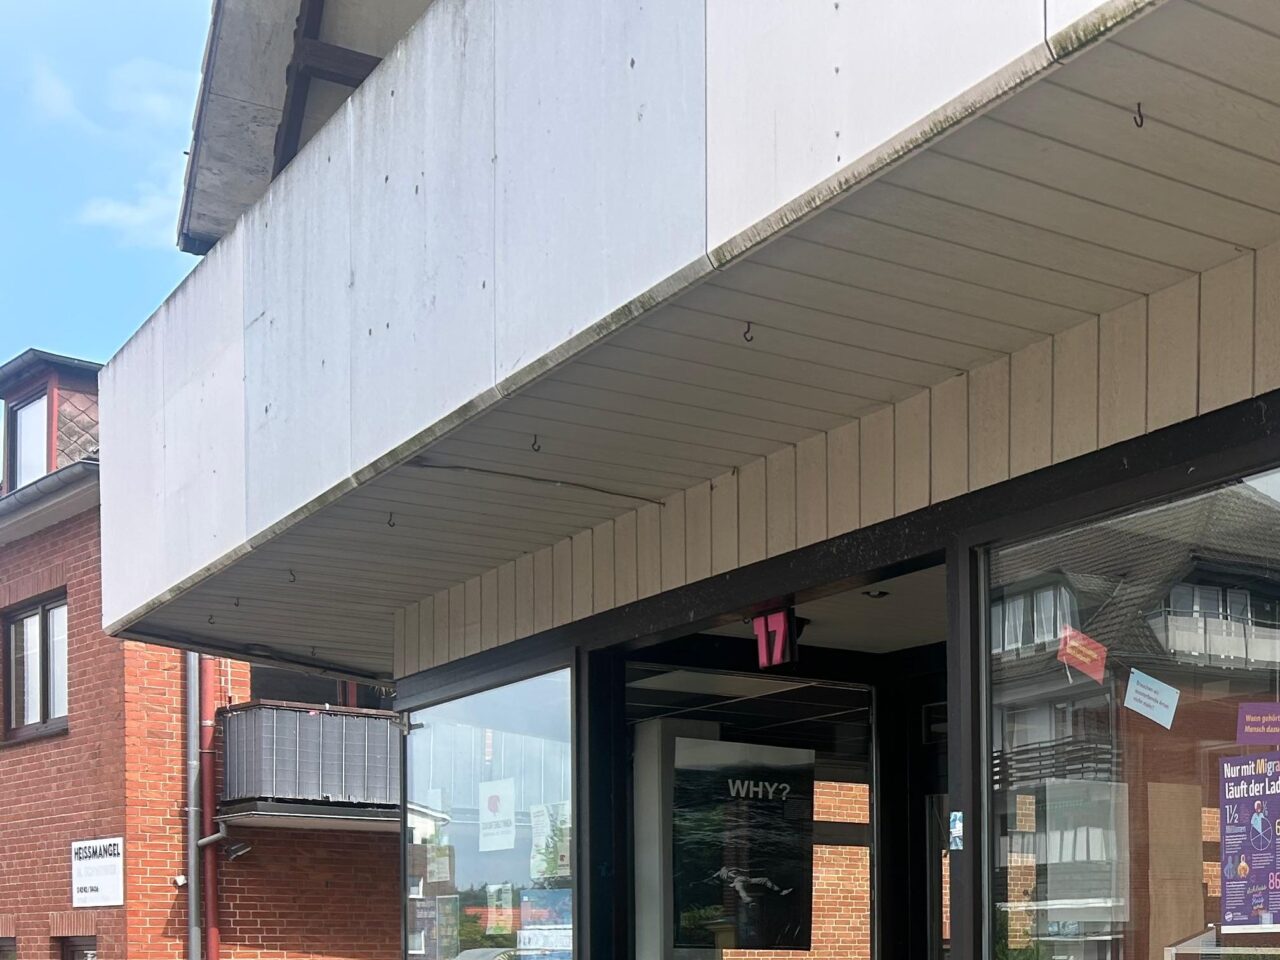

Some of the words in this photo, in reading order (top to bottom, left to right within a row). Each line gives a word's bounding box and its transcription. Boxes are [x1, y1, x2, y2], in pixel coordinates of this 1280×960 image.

[753, 610, 786, 669] 17
[1223, 762, 1240, 779] Nur
[1240, 760, 1256, 777] mit
[727, 778, 791, 800] WHY?
[1225, 779, 1248, 800] läuft
[1248, 778, 1266, 796] der
[74, 842, 121, 861] HEISSMANGEL
